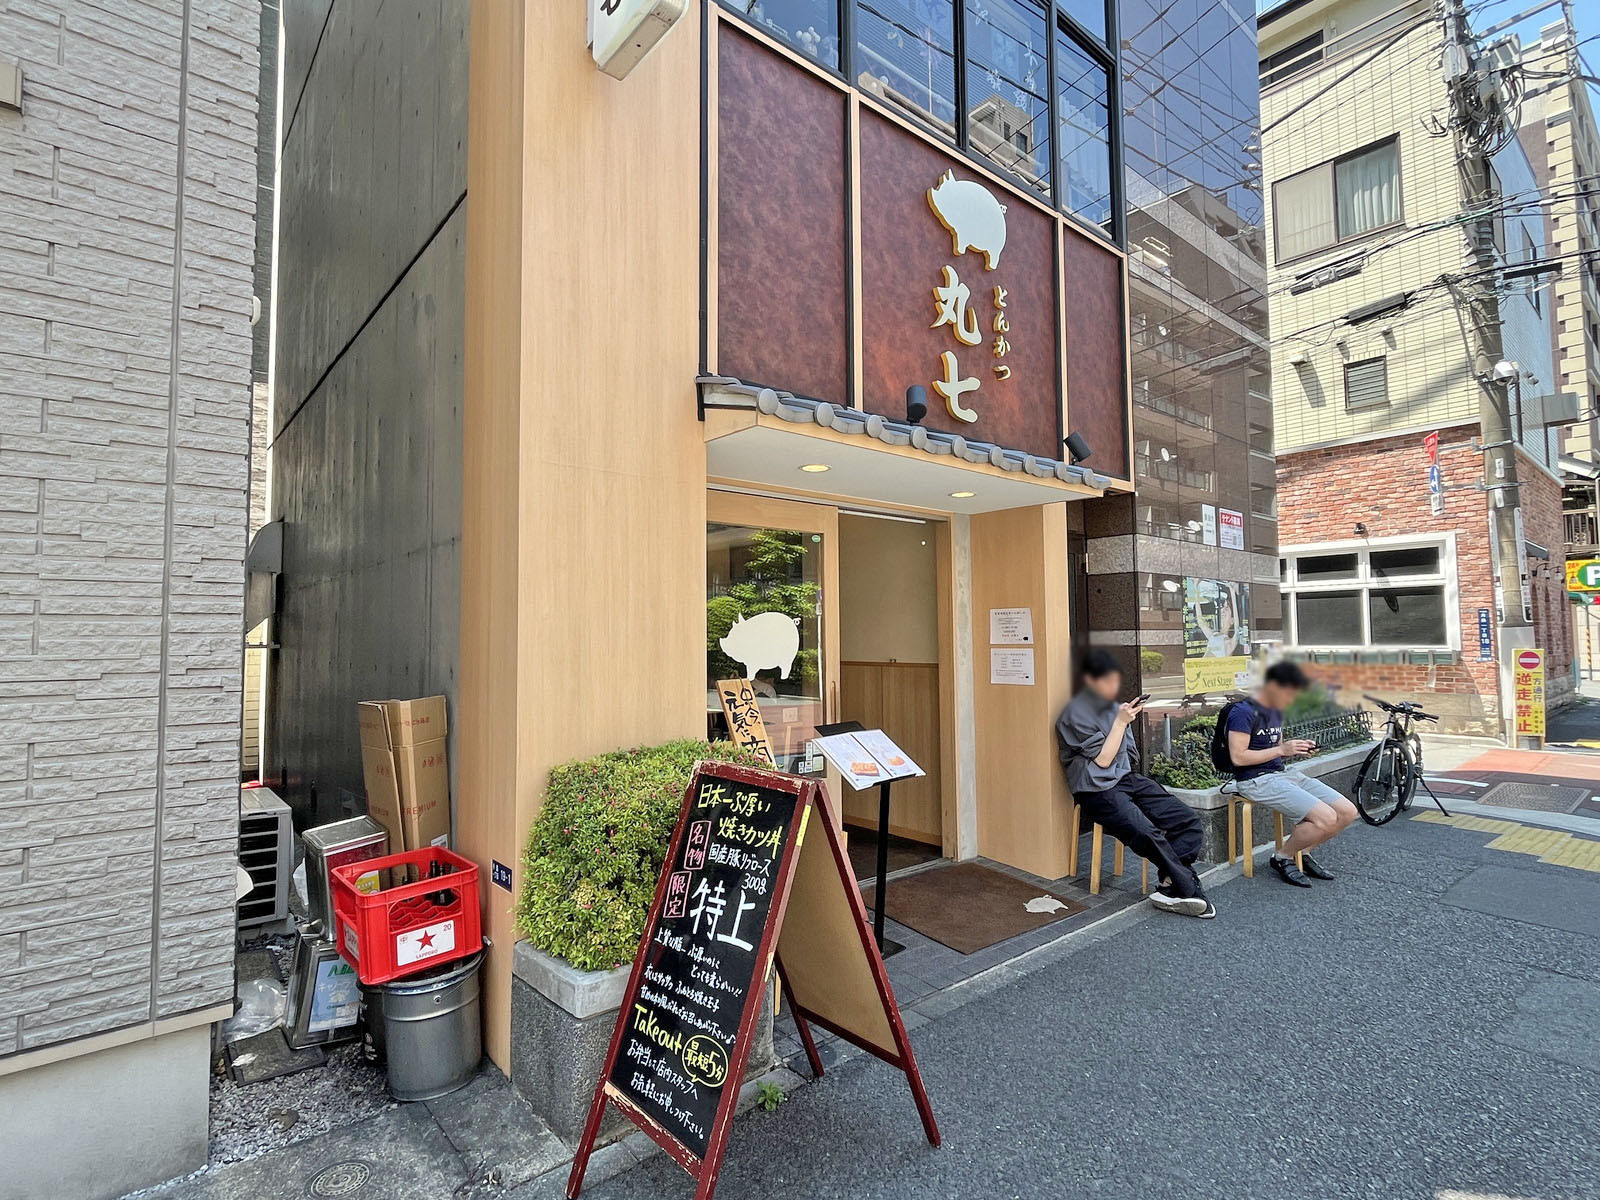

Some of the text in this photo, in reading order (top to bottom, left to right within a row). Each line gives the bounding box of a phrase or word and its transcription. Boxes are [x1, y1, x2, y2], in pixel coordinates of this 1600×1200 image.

[930, 265, 982, 424] 丸七
[993, 285, 1011, 381] とんかつ
[1202, 676, 1232, 689] Next Stage
[1516, 672, 1532, 733] 逆走禁止
[1533, 671, 1543, 703] 一方通行
[697, 783, 771, 817] 日本一ぶ厚い
[687, 823, 705, 867] 名物
[708, 842, 773, 877] 国産豚リブロース
[667, 874, 686, 917] 限定
[741, 872, 767, 896] 300g
[443, 923, 452, 932] 20
[690, 877, 756, 952] 特上
[415, 948, 439, 960] SAPPORO
[634, 1003, 682, 1055] Takeout
[685, 1040, 724, 1081] 最短5分
